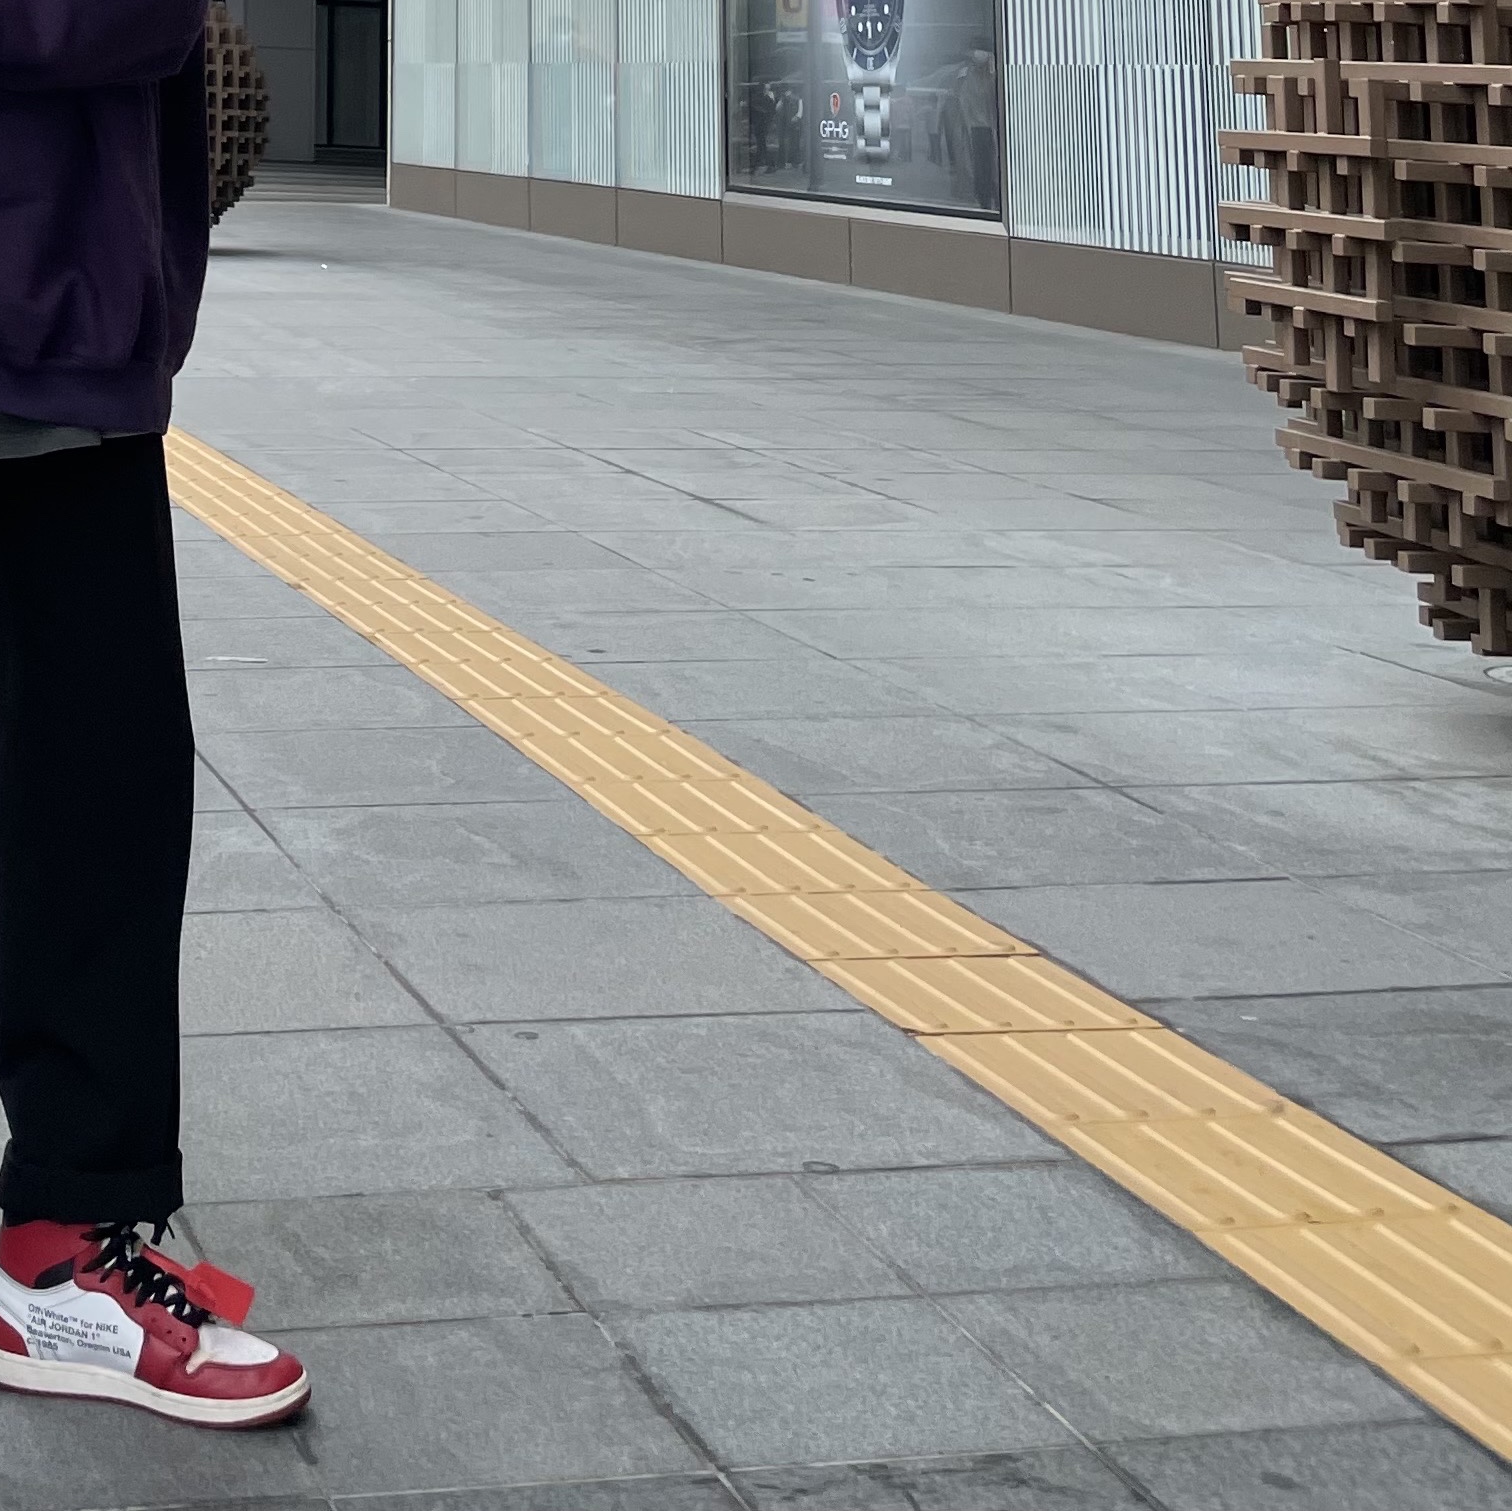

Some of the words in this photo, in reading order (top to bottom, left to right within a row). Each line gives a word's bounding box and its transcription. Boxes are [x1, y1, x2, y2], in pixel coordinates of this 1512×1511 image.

[819, 120, 849, 138] GPHG
[48, 1321, 88, 1339] JORDAN
[80, 1319, 94, 1329] for
[95, 1322, 119, 1334] NIKE
[76, 1339, 111, 1353] Oregon
[113, 1346, 132, 1359] USA
